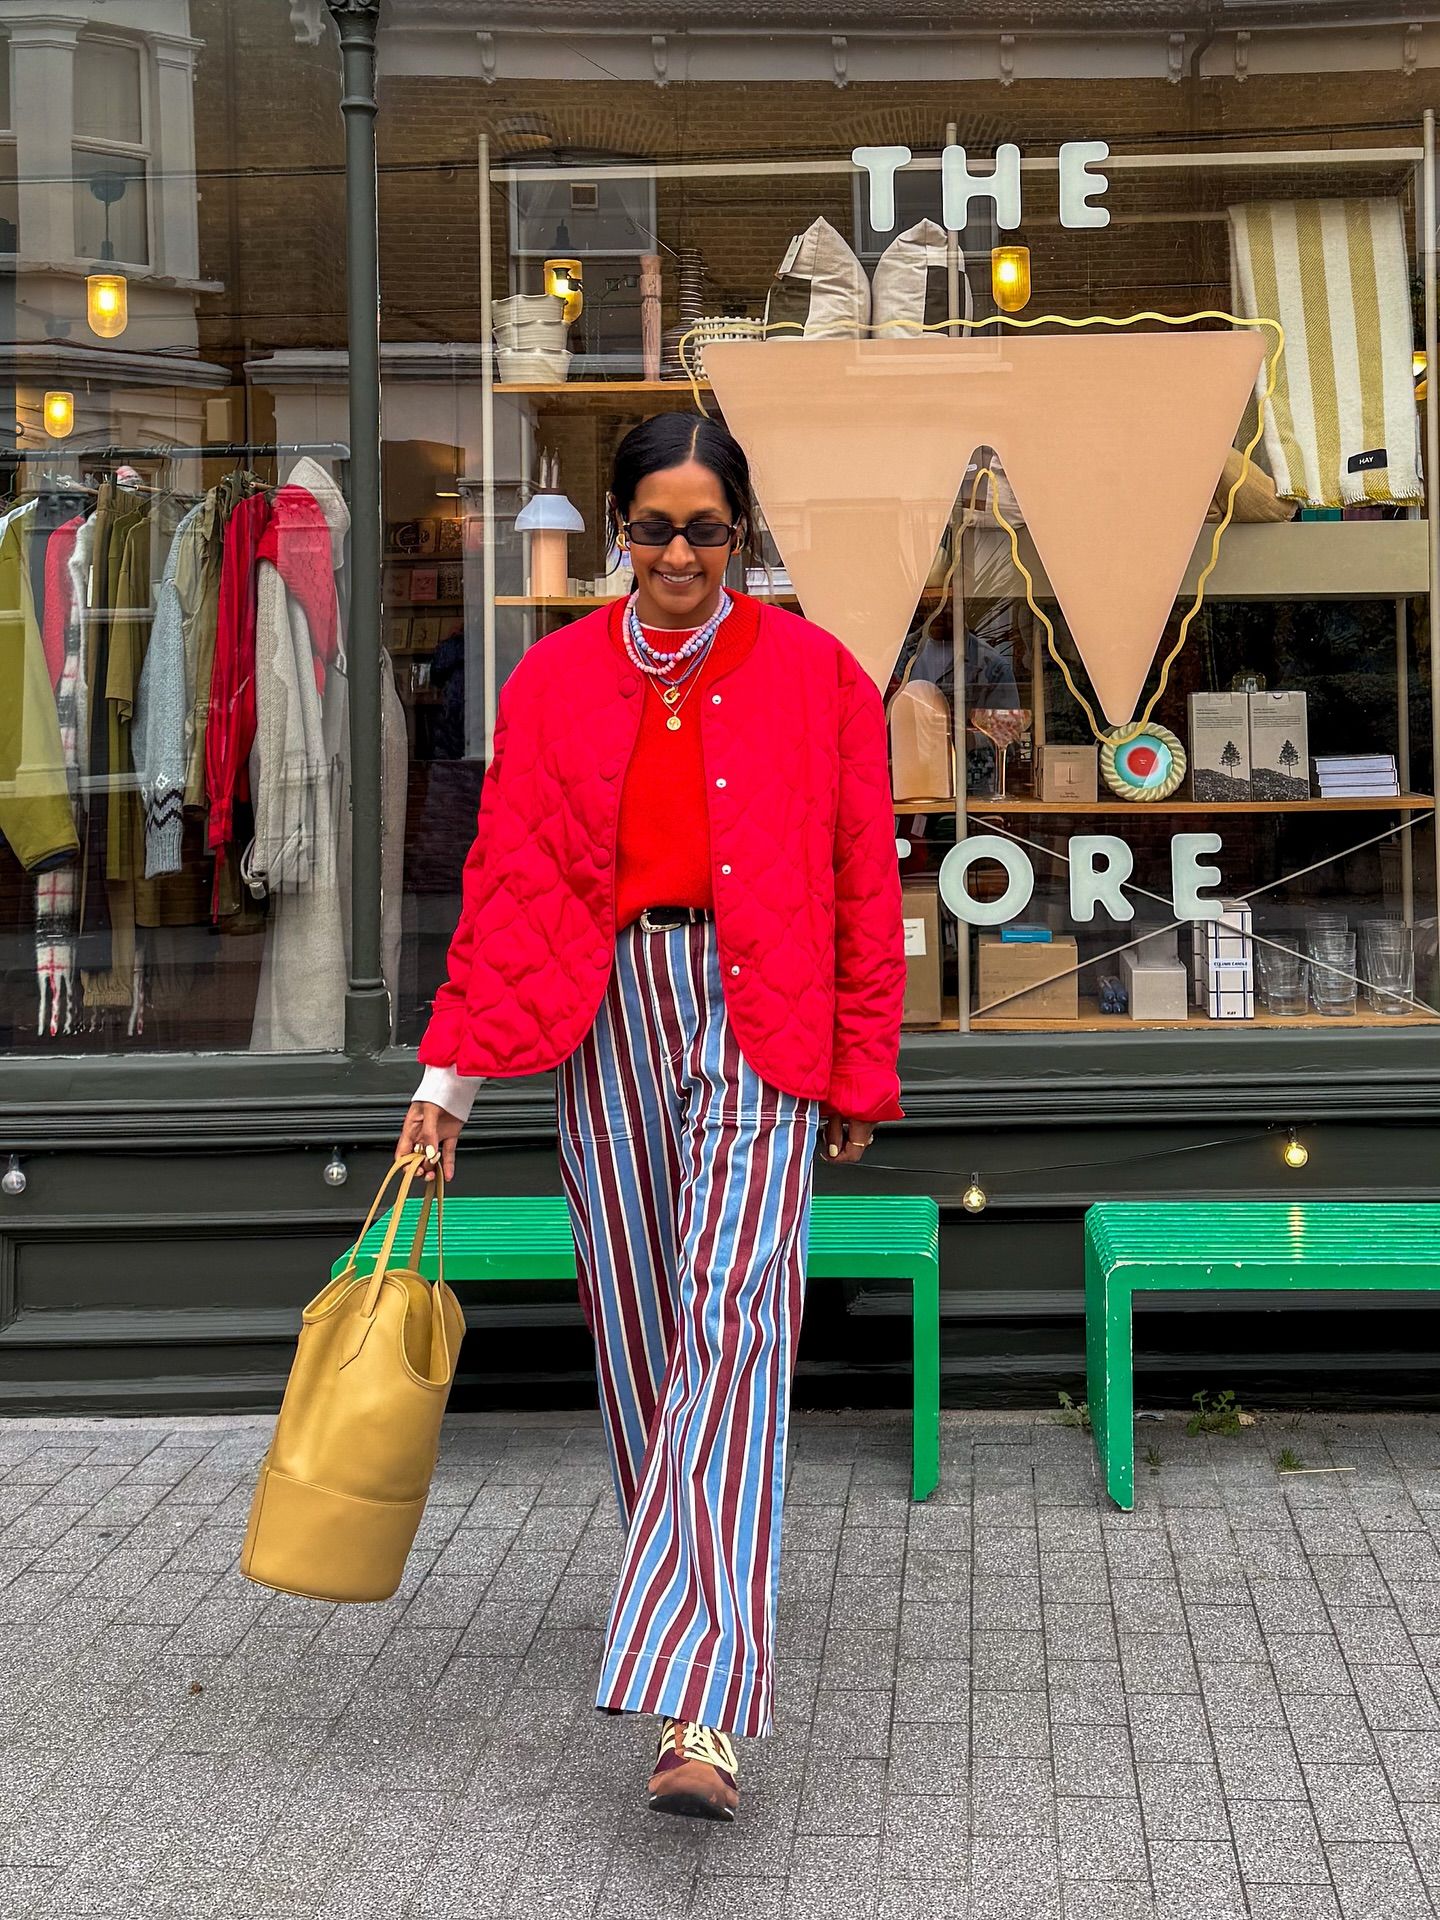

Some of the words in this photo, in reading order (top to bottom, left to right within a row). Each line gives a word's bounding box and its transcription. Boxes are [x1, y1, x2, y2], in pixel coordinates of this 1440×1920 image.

[852, 141, 1110, 232] THE
[1359, 456, 1374, 465] HAY
[895, 833, 1223, 926] ORE
